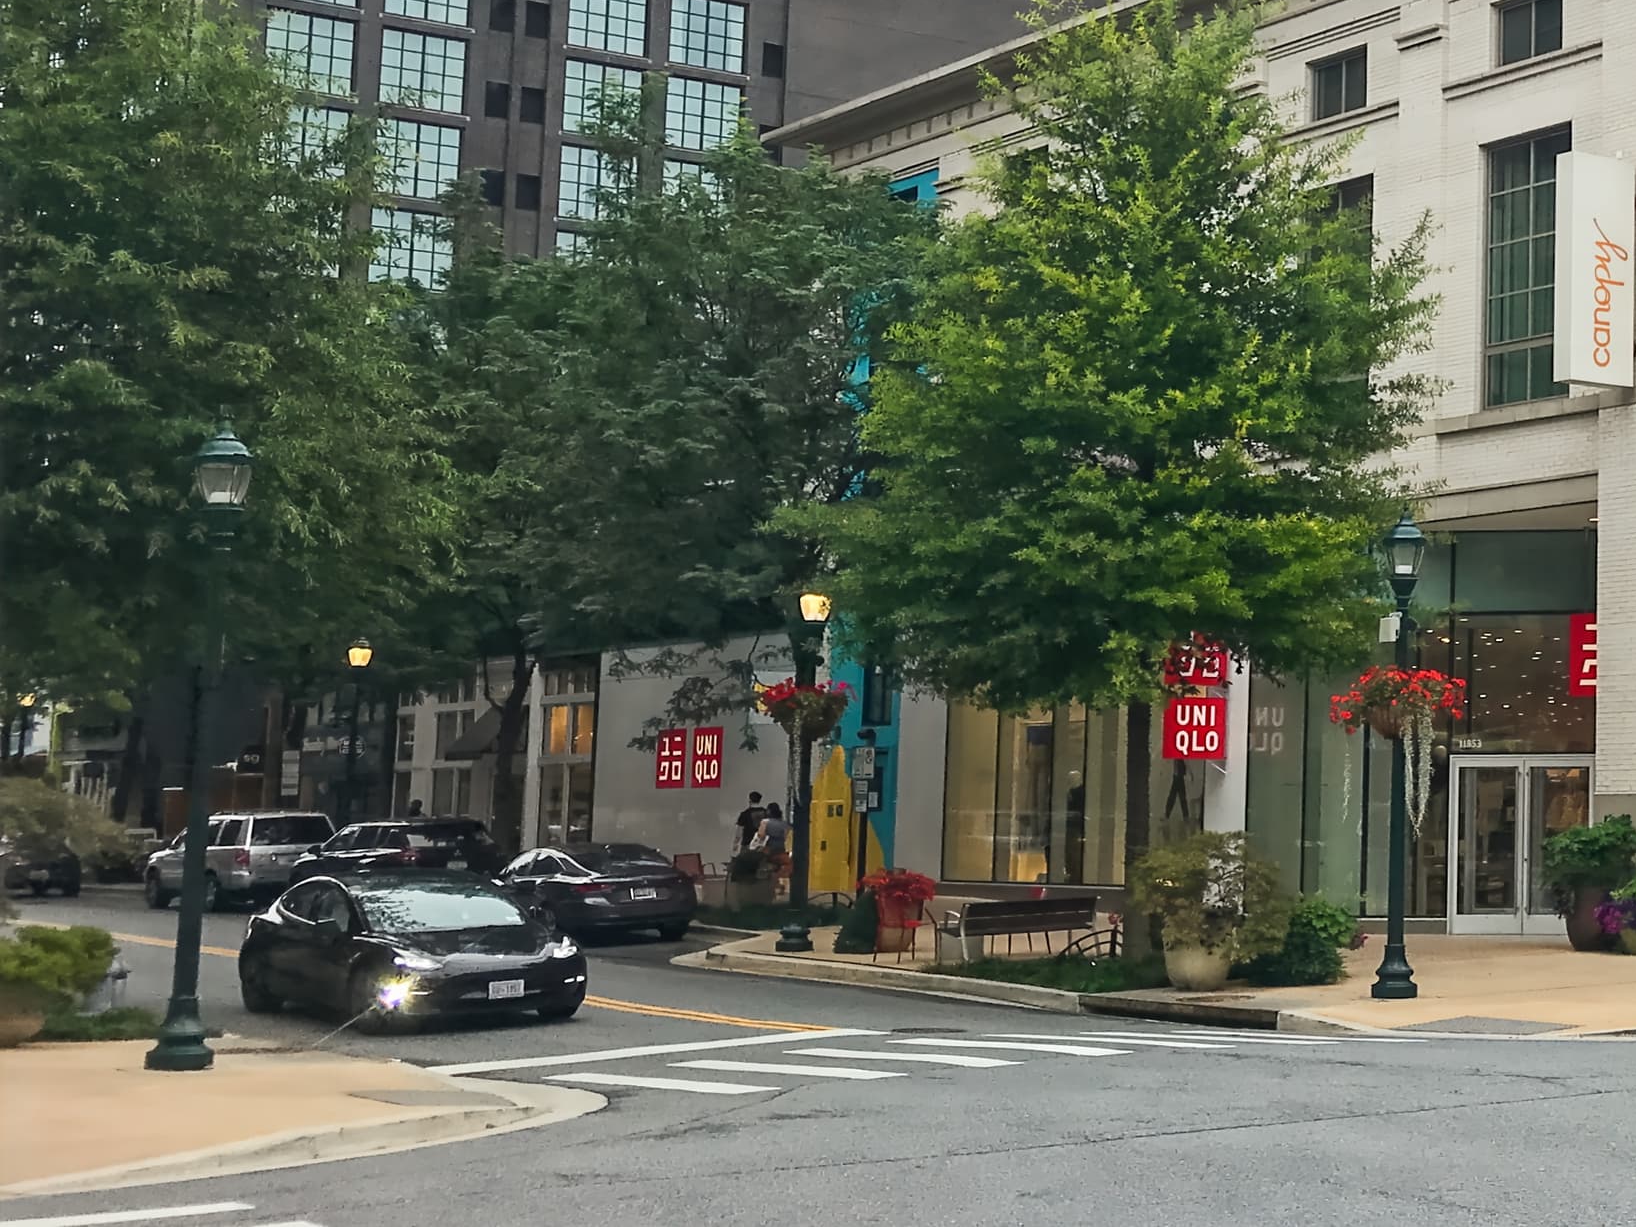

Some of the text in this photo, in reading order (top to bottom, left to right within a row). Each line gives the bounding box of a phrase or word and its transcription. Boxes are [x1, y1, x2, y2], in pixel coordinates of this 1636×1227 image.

[1593, 217, 1628, 367] canopy
[1176, 704, 1217, 727] UNI
[696, 734, 718, 755] UNI
[1175, 730, 1219, 756] QLO
[695, 759, 718, 784] QLO
